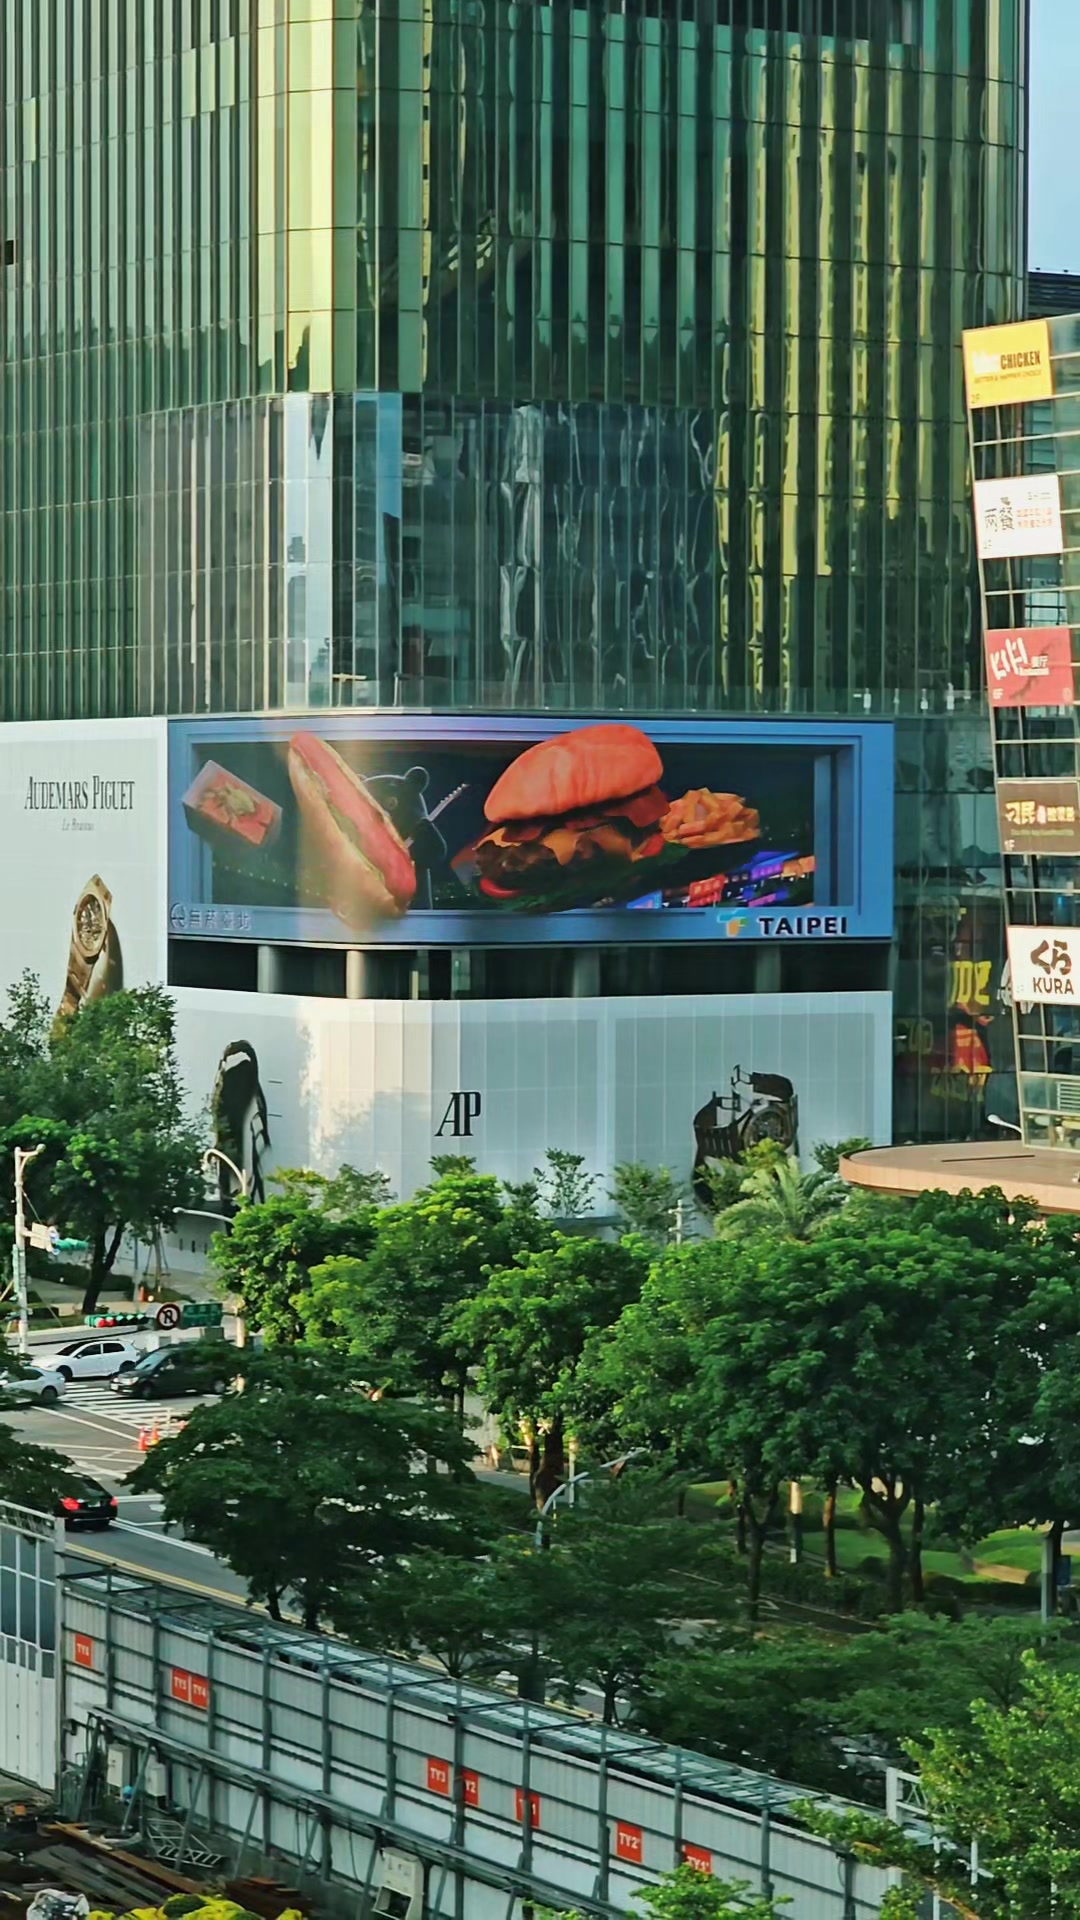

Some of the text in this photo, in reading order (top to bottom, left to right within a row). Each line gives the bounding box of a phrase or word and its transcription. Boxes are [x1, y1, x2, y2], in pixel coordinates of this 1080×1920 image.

[1000, 350, 1041, 370] CHICKEN
[24, 775, 135, 810] AUDEMARS PIGUET
[759, 916, 847, 935] TAIPEI
[1030, 939, 1072, 975] くら
[1032, 977, 1074, 995] KURA
[433, 1091, 481, 1137] AP
[430, 1767, 446, 1783] TY3
